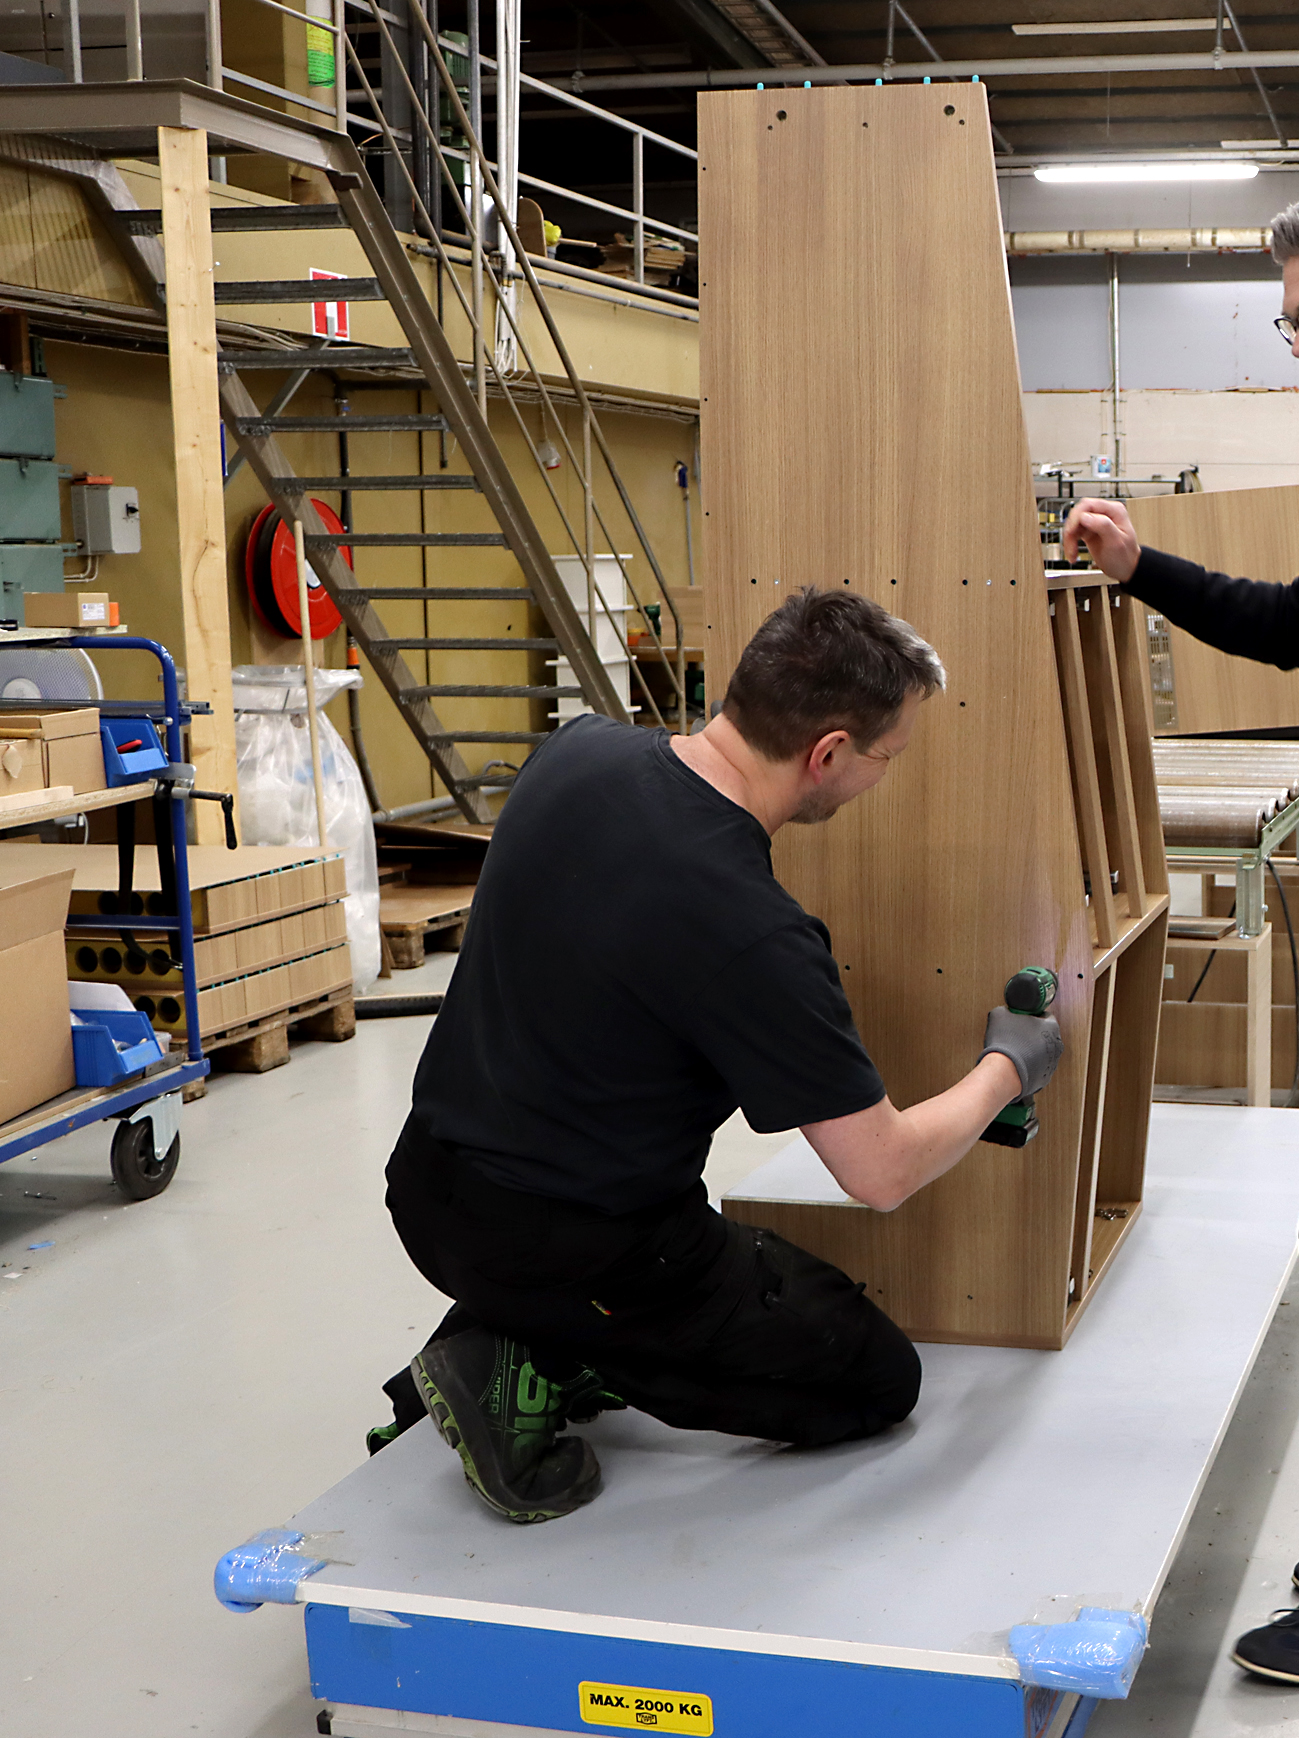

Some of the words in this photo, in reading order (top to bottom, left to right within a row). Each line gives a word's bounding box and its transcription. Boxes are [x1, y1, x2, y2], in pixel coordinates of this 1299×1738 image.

[589, 1693, 630, 1709] MAX.
[635, 1698, 674, 1713] 2000
[679, 1702, 703, 1716] KG
